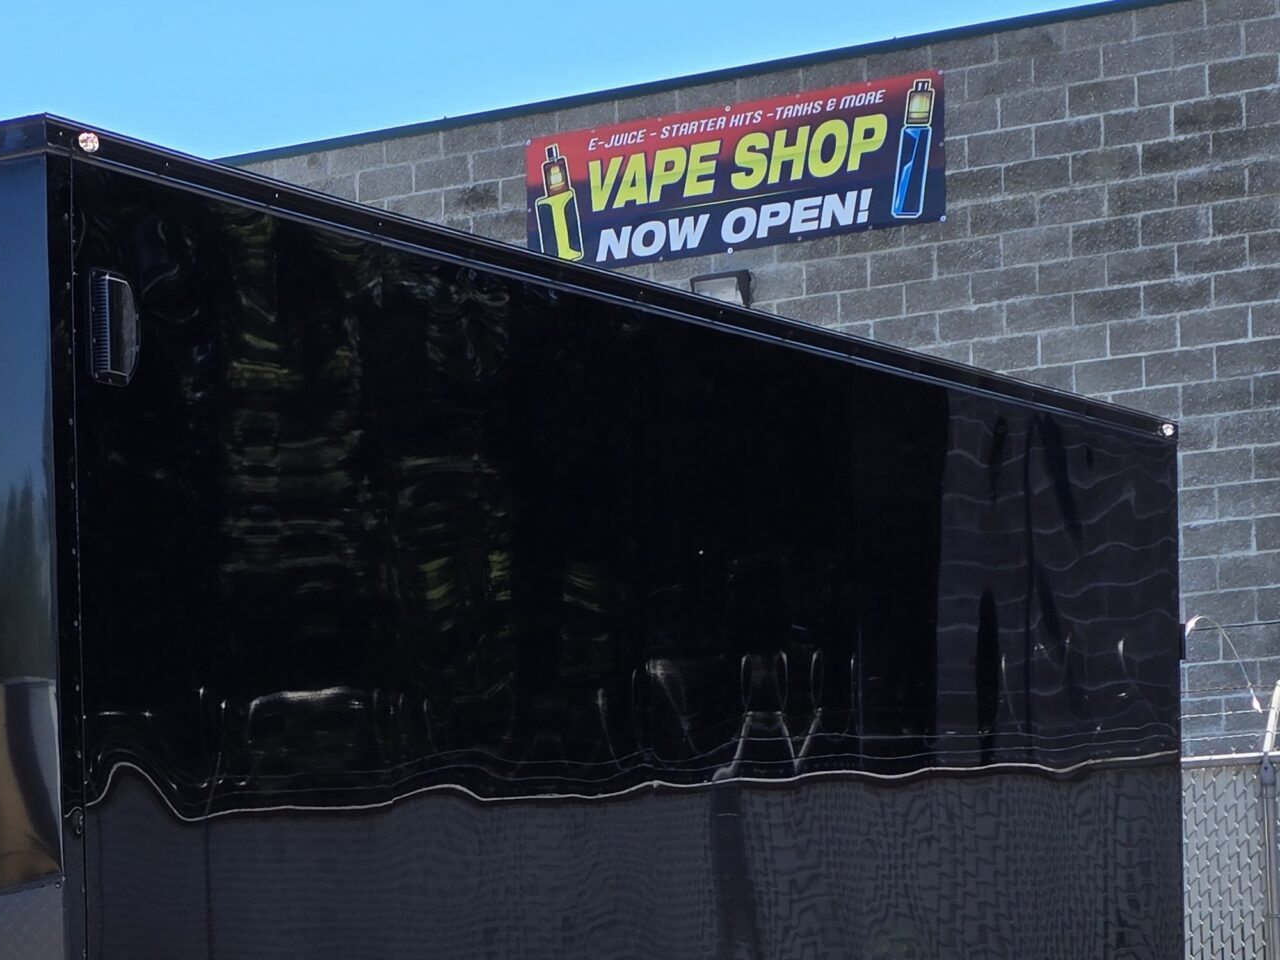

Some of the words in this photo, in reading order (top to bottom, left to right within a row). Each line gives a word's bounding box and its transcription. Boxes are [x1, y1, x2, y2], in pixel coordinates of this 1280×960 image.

[587, 129, 647, 151] E-JUICE
[659, 116, 726, 139] STARTER
[825, 98, 837, 112] &
[839, 89, 886, 110] MORE
[588, 140, 722, 212] VAPE
[730, 112, 888, 191] SHOP
[595, 213, 710, 262] NOW
[721, 188, 873, 244] OPEN!
